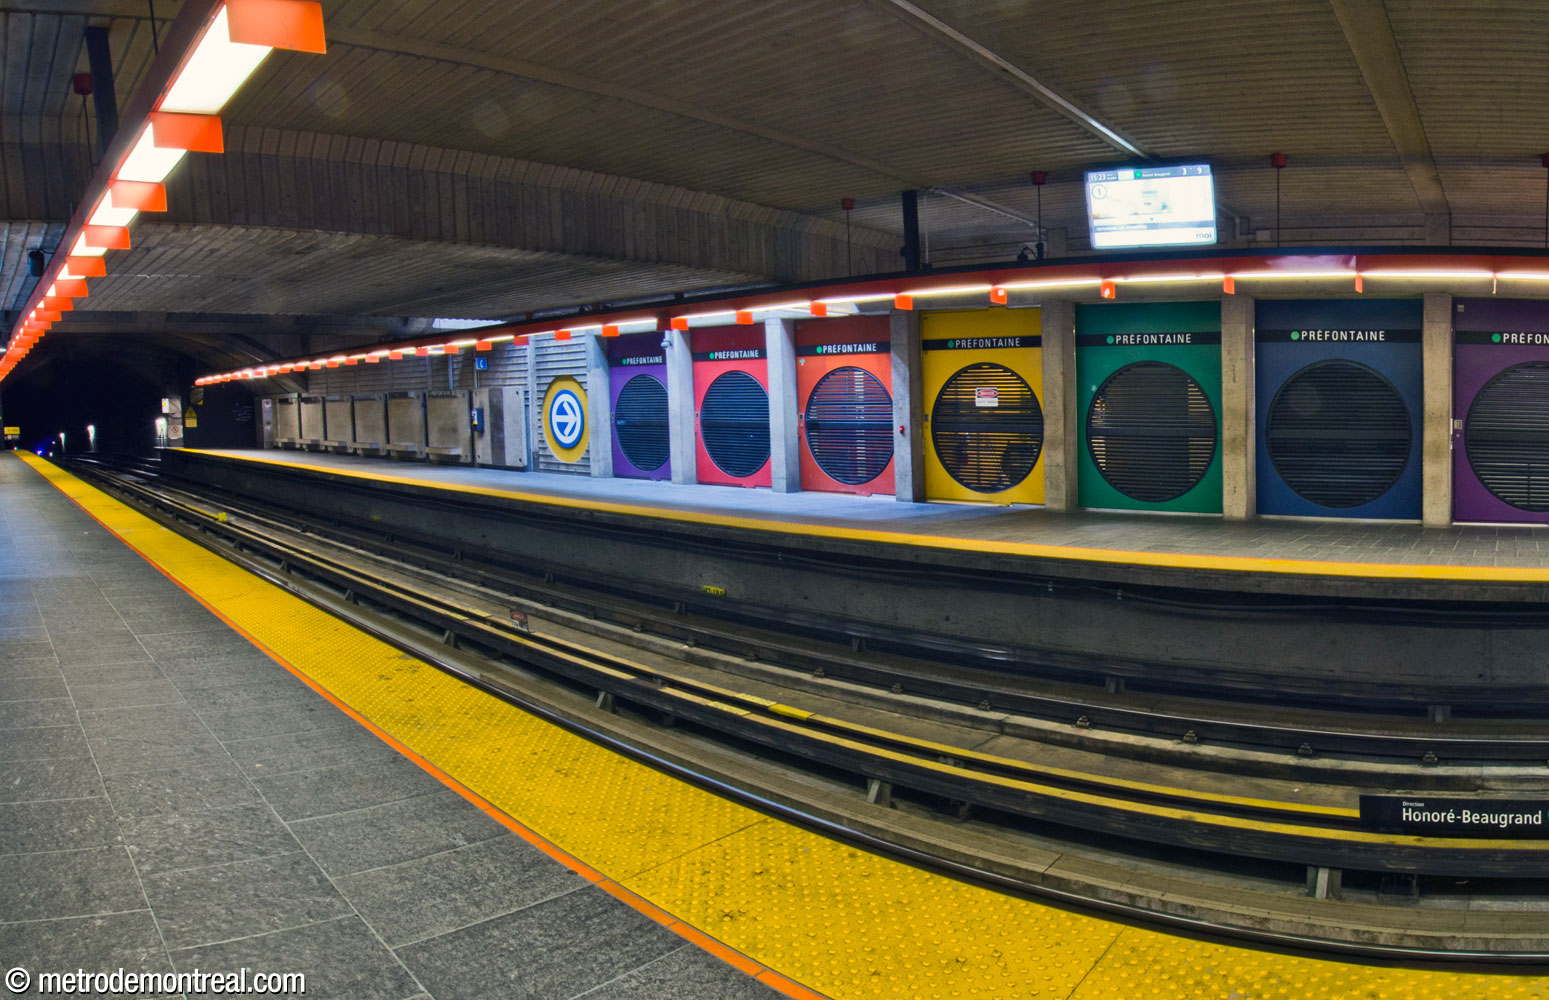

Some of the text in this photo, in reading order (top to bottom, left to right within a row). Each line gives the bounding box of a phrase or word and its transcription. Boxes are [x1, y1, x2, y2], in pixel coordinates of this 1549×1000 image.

[1182, 166, 1202, 176] 3 9
[1115, 333, 1191, 345] PRÉFONTAINE
[1301, 330, 1385, 341] PRÉFONTAINE
[822, 343, 877, 354] PRÉFONTAINE
[955, 337, 1020, 349] PRÉFONTAINE
[626, 355, 663, 365] PRÉFONTAINE
[714, 349, 759, 360] PRÉFONTAINE
[1402, 807, 1542, 828] Honoré-Beaugrand
